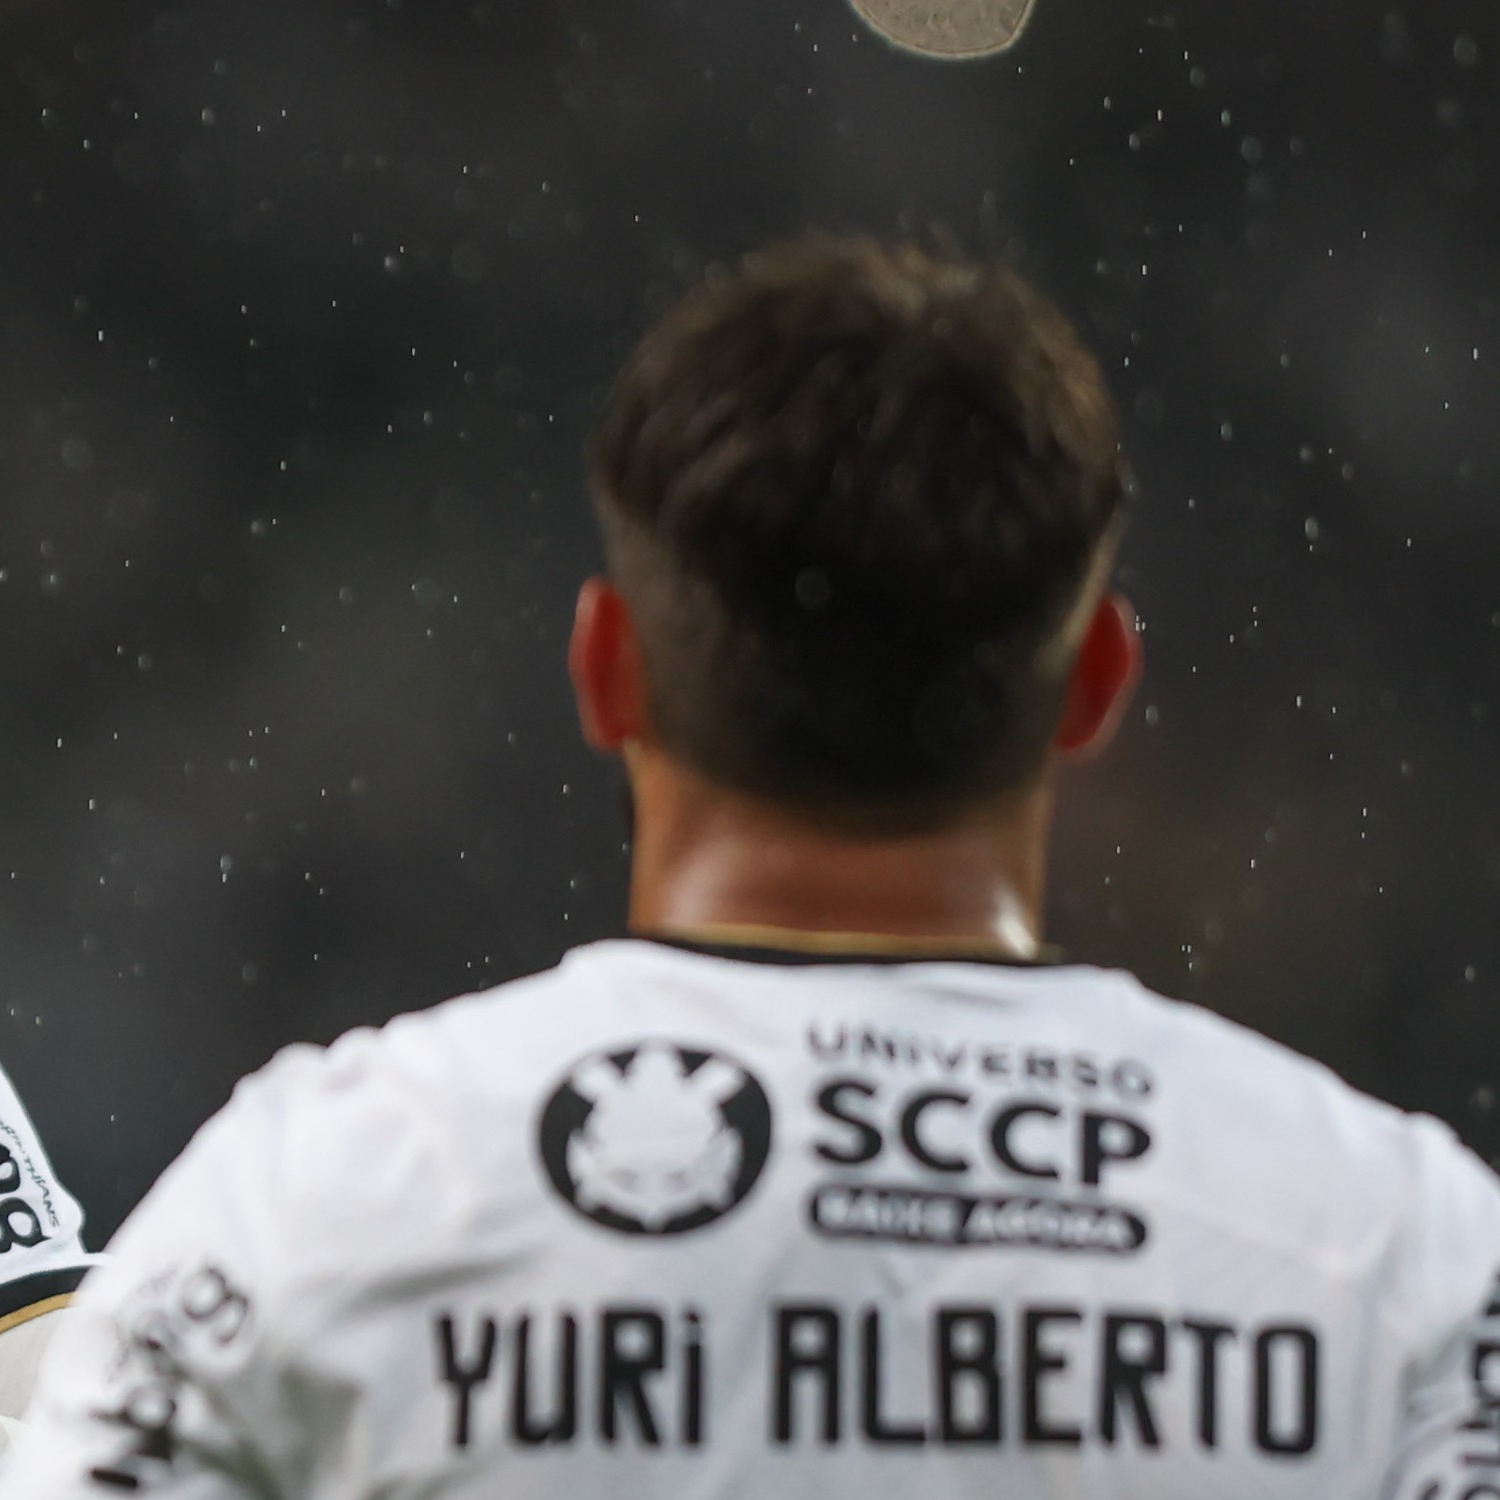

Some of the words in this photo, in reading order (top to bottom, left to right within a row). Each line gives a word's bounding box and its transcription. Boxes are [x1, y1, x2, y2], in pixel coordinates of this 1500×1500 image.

[808, 1026, 1156, 1100] UNIVERSO
[814, 1081, 1152, 1186] SCCP
[770, 1305, 1320, 1458] ALBERTO
